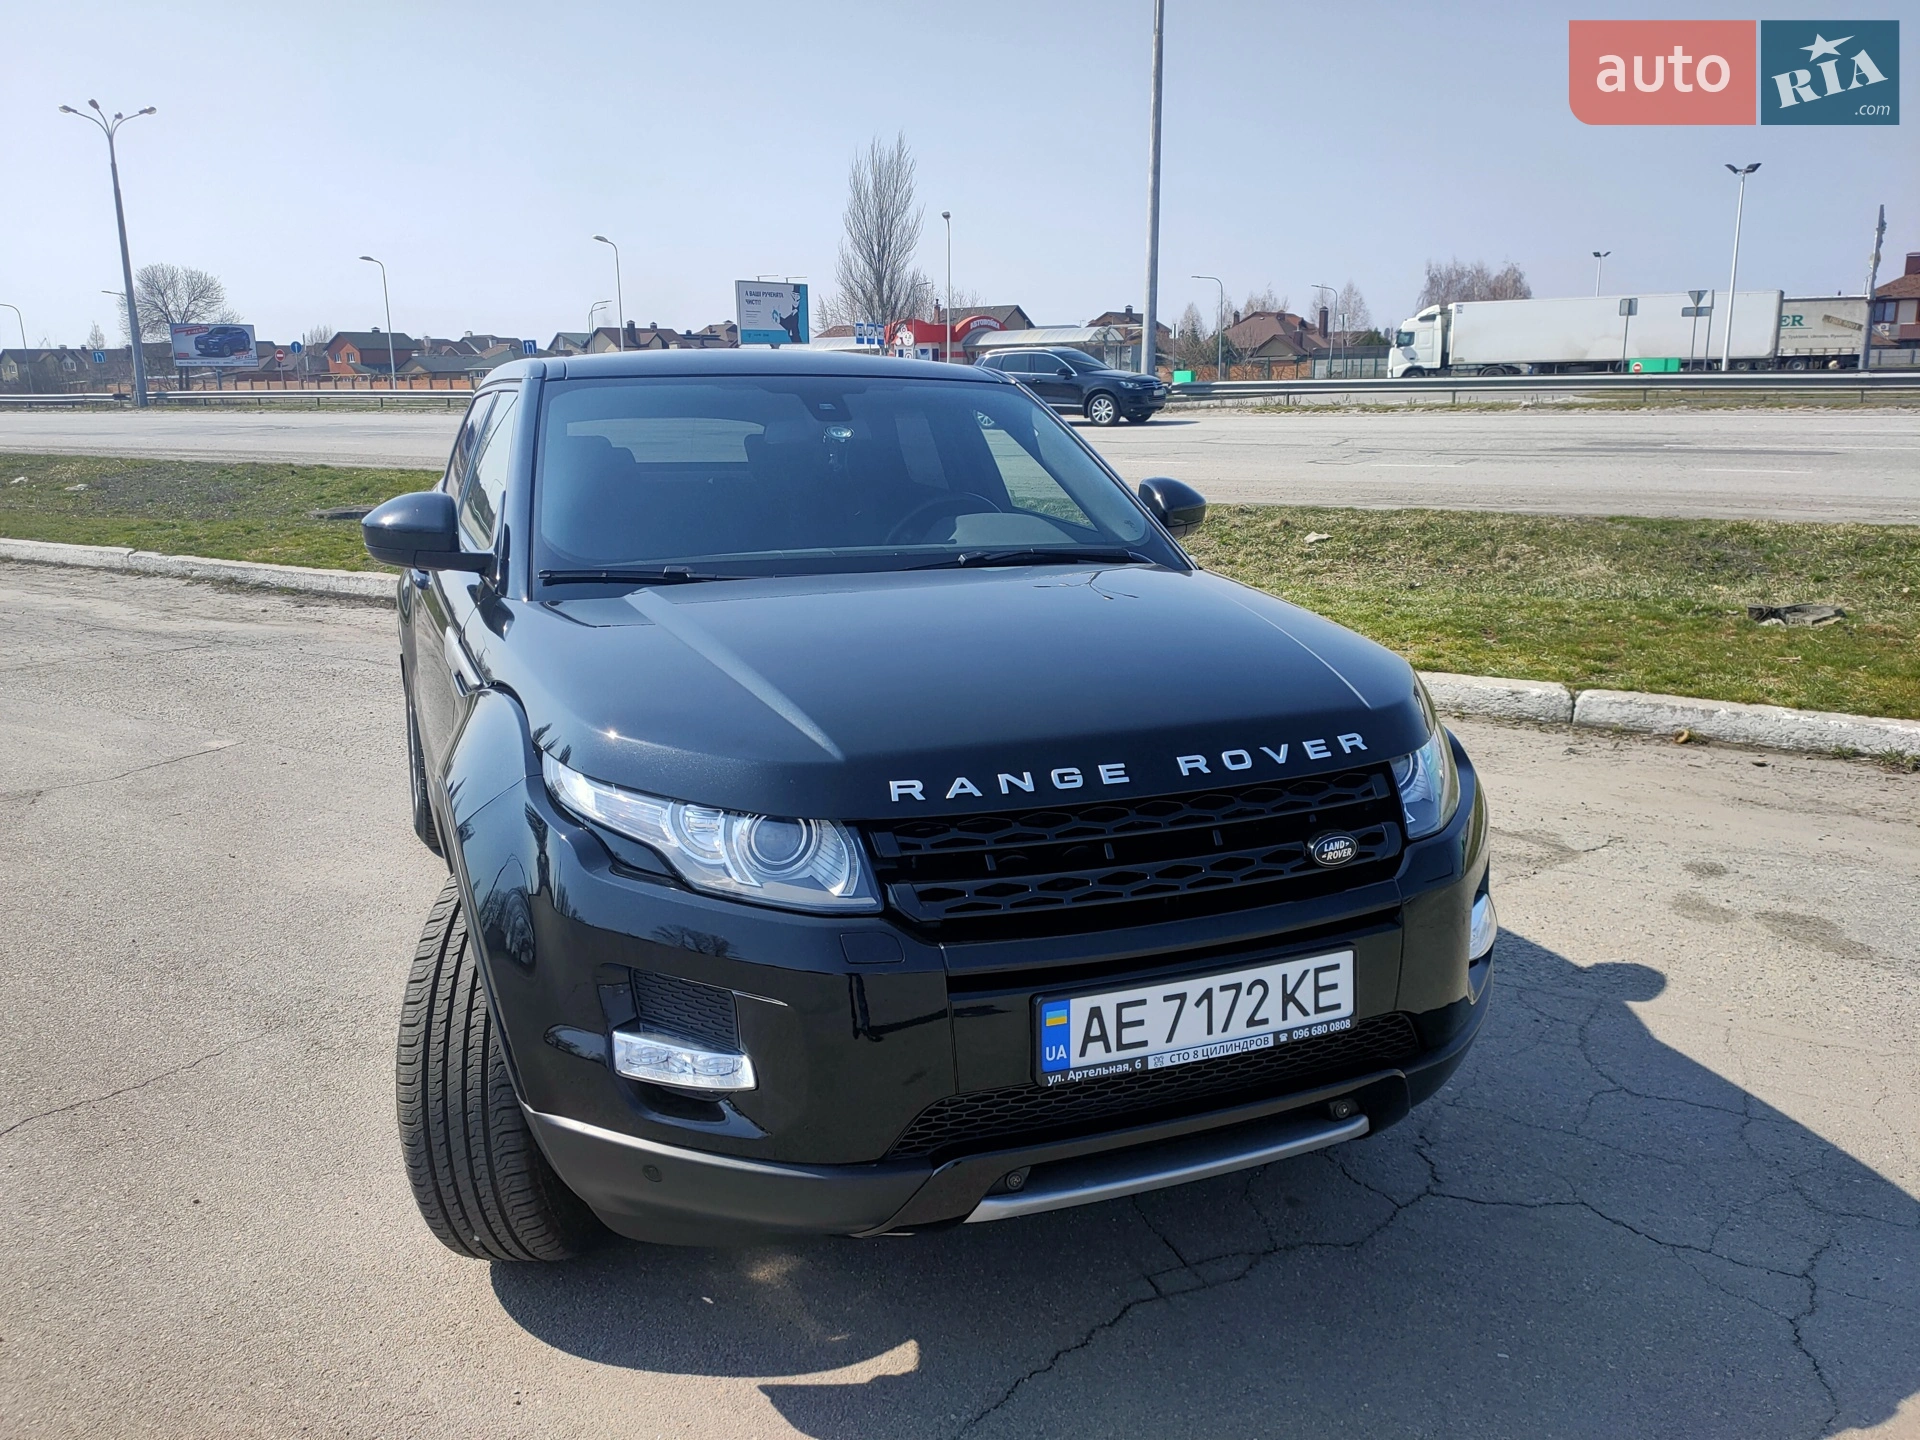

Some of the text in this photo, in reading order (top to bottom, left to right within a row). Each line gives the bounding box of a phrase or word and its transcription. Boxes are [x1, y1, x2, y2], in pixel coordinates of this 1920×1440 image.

[888, 732, 1369, 802] RANGE ROVER
[1323, 840, 1345, 852] LAND
[1326, 847, 1352, 861] ROVER
[1078, 963, 1342, 1058] AE 7172 KE
[1292, 1019, 1351, 1040] 096 680 0808
[1045, 1044, 1068, 1062] UA
[1169, 1036, 1270, 1063] СТО 8 ЦИЛИНДРОВ
[1047, 1059, 1142, 1087] ул. Артельная, 6
